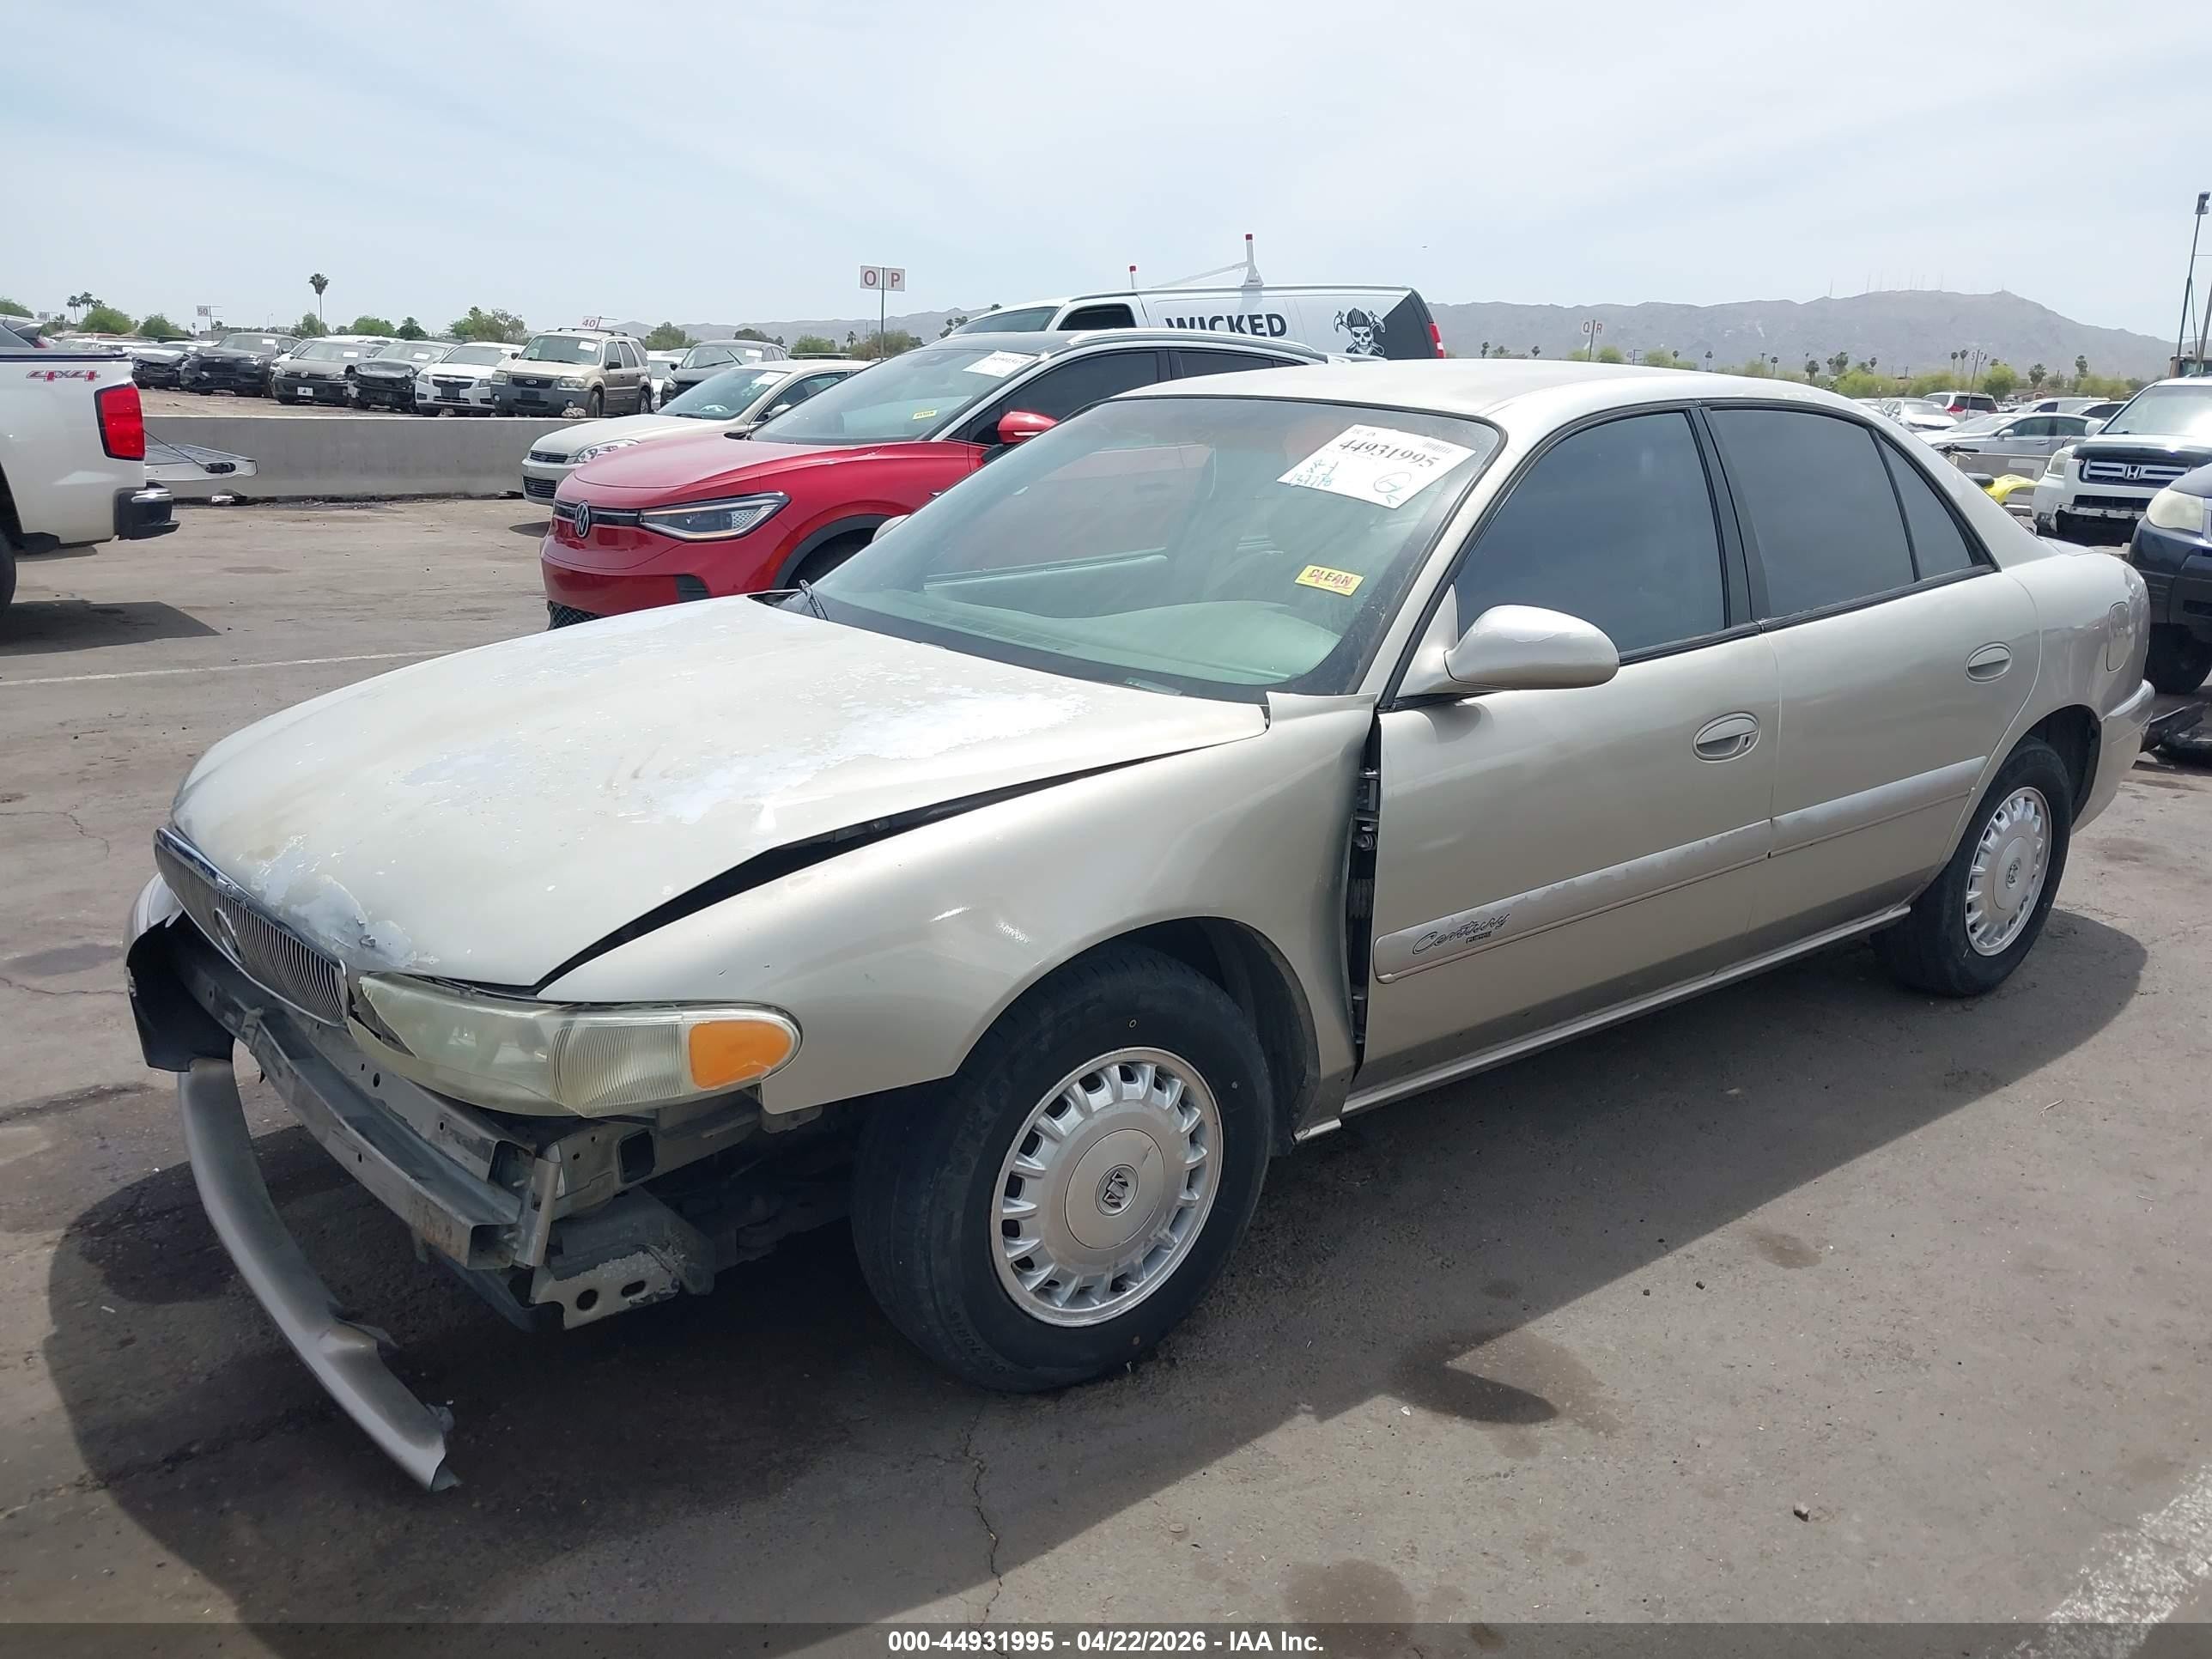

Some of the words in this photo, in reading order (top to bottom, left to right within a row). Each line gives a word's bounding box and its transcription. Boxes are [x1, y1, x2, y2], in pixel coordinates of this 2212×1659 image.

[864, 270, 877, 286] O
[890, 272, 901, 288] P
[582, 319, 596, 328] 40
[1339, 439, 1440, 468] 44931995
[1310, 568, 1354, 586] CLEAN
[1412, 913, 1510, 955] Century
